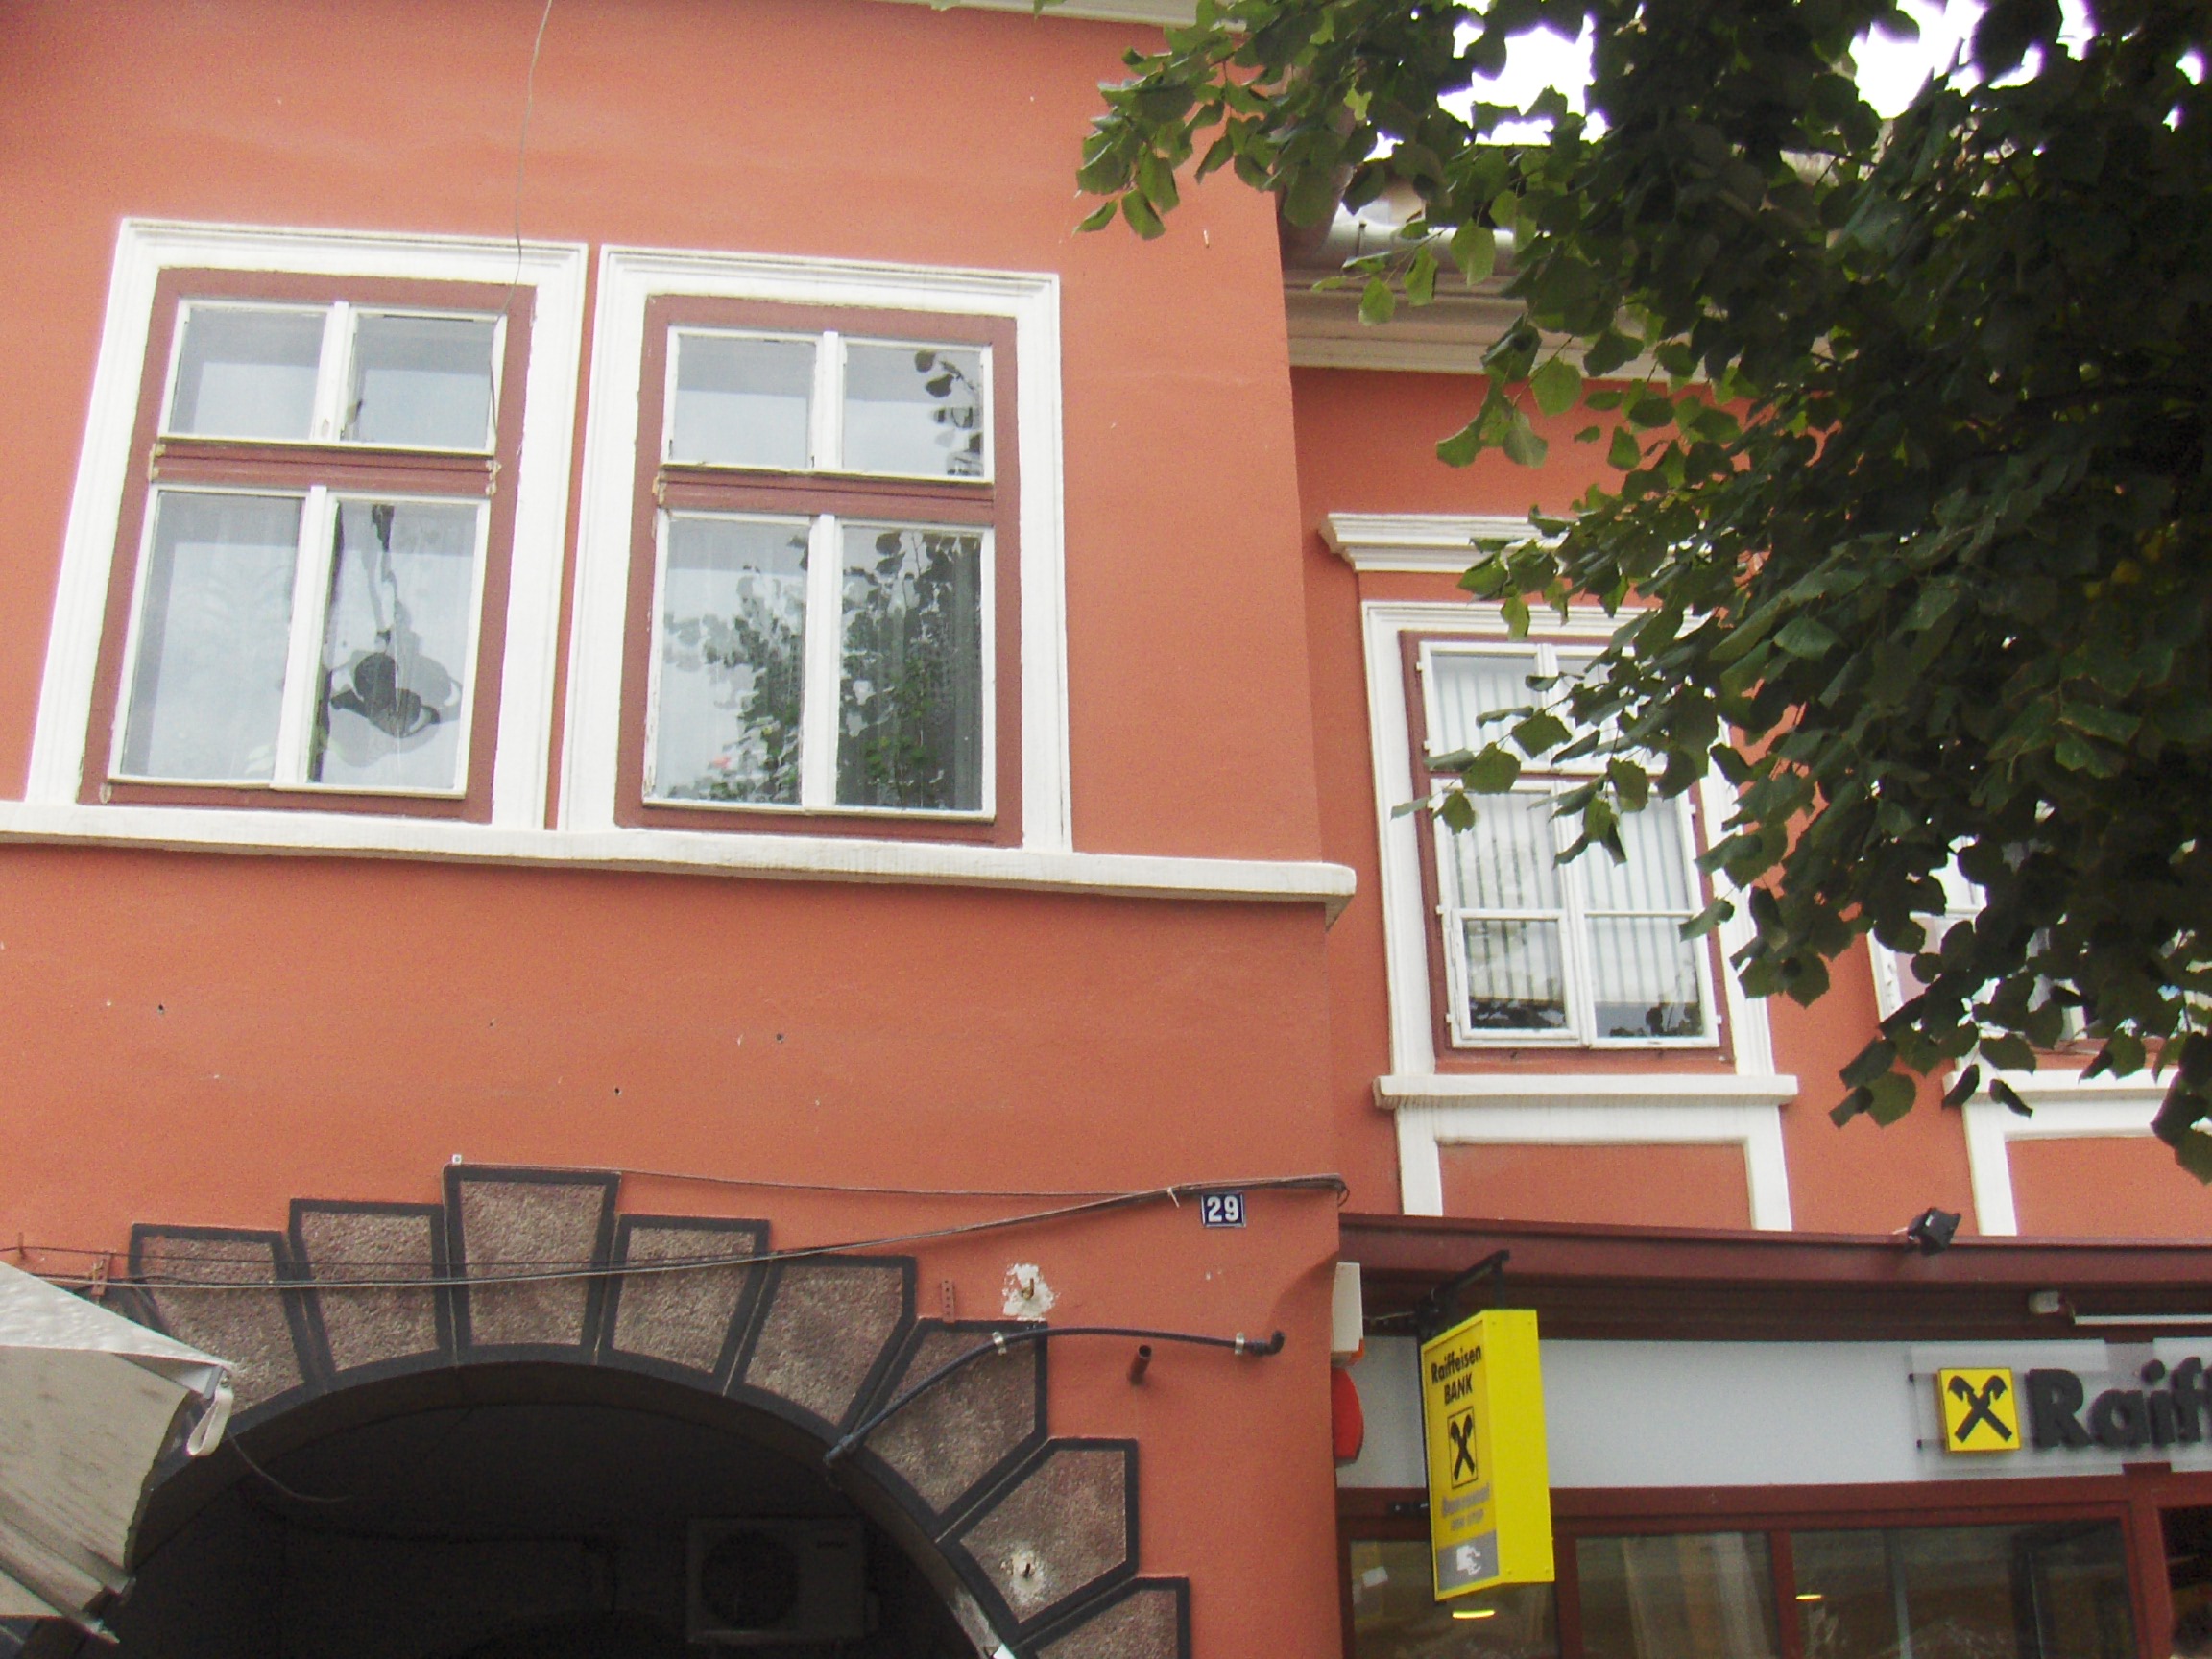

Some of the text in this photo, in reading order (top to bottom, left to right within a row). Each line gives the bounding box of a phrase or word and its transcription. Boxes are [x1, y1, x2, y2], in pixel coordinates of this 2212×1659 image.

[1207, 1195, 1239, 1222] 29
[1431, 1345, 1482, 1384] Raiffeisen
[1444, 1372, 1473, 1406] BANK
[2025, 1356, 2212, 1450] Raif
